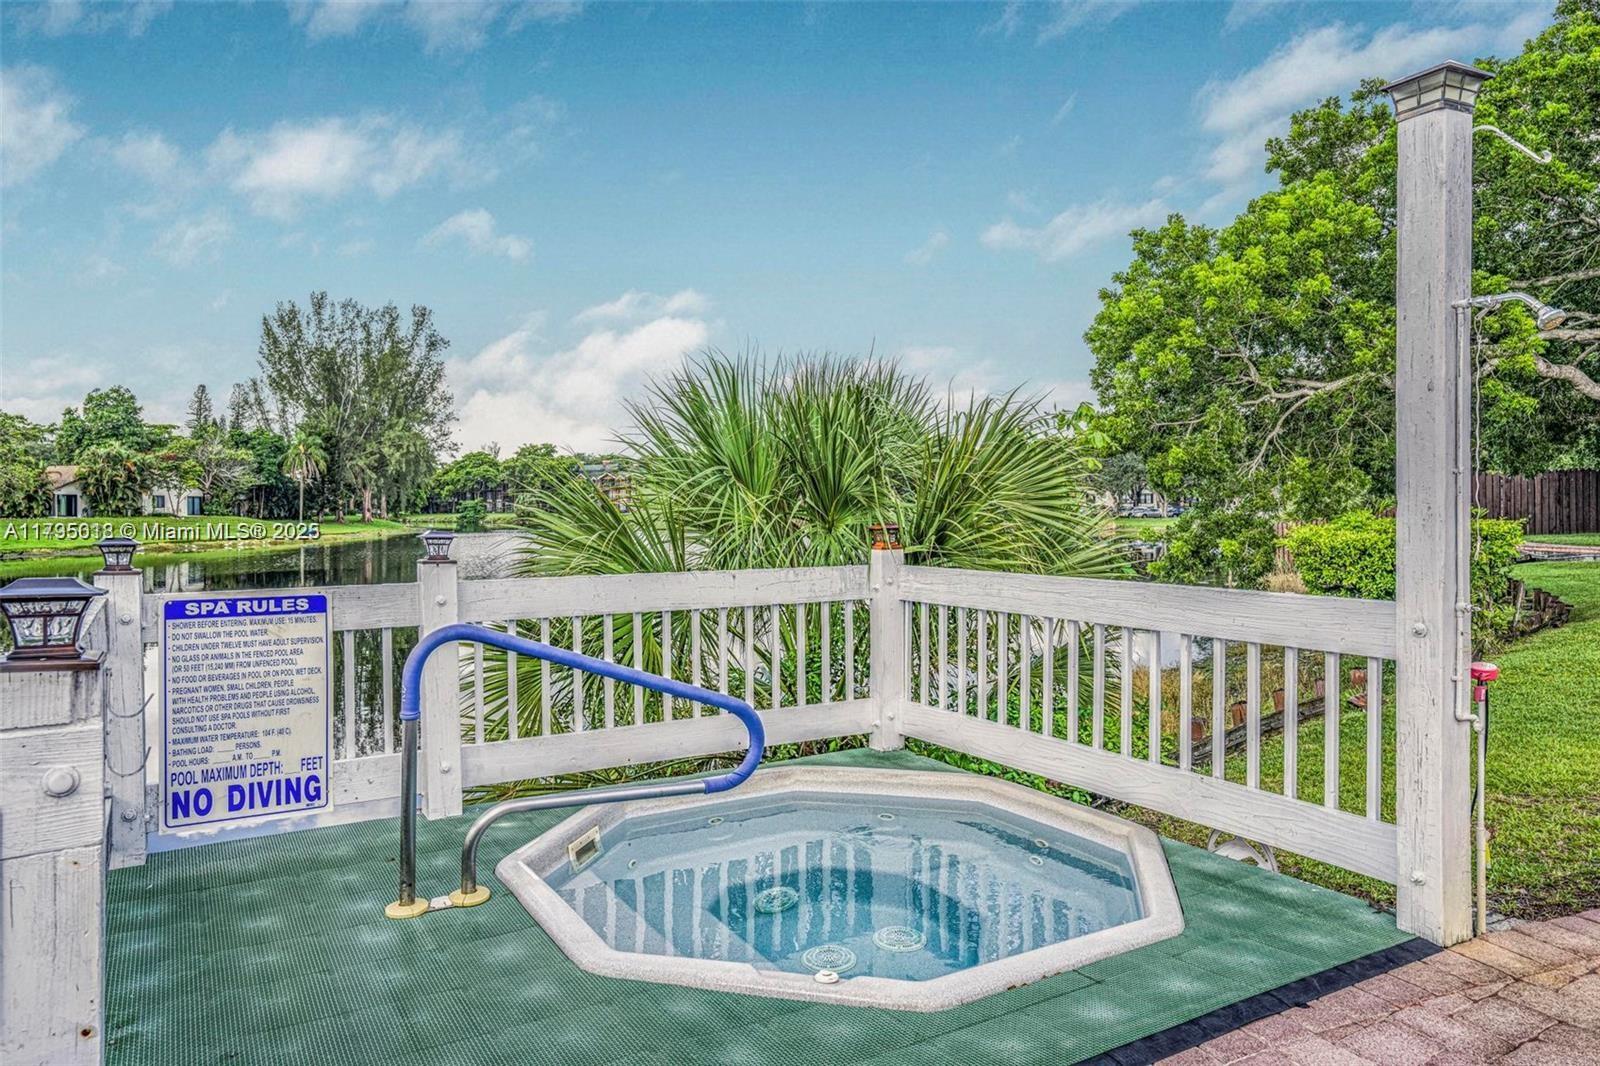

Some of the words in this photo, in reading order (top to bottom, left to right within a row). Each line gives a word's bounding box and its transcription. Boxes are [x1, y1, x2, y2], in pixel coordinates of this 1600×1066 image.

[185, 600, 230, 616] SPA
[236, 598, 309, 613] RULES
[172, 622, 196, 630] SHOWER
[198, 620, 219, 628] BEFORE
[288, 616, 294, 624] 15
[172, 633, 180, 641] DO
[181, 632, 193, 640] NOT
[194, 631, 221, 640] SWALLOW
[223, 630, 233, 638] THE
[172, 644, 199, 652] CHILDREN
[201, 642, 219, 650] UNDER
[221, 641, 241, 649] TWELVE
[243, 640, 257, 648] MUST
[273, 638, 289, 646] ADULT
[172, 655, 180, 663] NO
[181, 654, 200, 662] GLASS
[201, 653, 209, 661] OR
[210, 652, 234, 660] ANIMALS
[184, 664, 189, 672] 50
[191, 664, 204, 672] FEET
[236, 660, 251, 668] FROM
[252, 659, 280, 667] UNFENCED
[172, 676, 180, 684] NO
[182, 675, 197, 683] FOOD
[198, 674, 206, 682] OR
[208, 672, 240, 681] BEVERAGES
[248, 671, 262, 679] POOL
[263, 670, 271, 678] OR
[172, 686, 202, 695] PREGNANT
[226, 683, 244, 691] SMALL
[274, 679, 294, 688] PEOPLE
[172, 697, 186, 705] WITH
[187, 696, 209, 704] HEALTH
[210, 693, 239, 701] PROBLEMS
[252, 690, 272, 699] PEOPLE
[274, 689, 289, 697] USING
[172, 705, 204, 714] NARCOTICS
[205, 704, 213, 712] OR
[214, 703, 233, 711] OTHER
[234, 702, 252, 710] DRUGS
[254, 700, 266, 708] THAT
[267, 699, 285, 707] CAUSE
[286, 696, 320, 705] DROWSINESS
[172, 716, 195, 725] SHOULD
[232, 711, 250, 719] POOLS
[252, 709, 274, 717] WITHOUT
[275, 708, 290, 716] FIRST
[172, 725, 207, 735] CONSULTING
[172, 737, 199, 745] MAXIMUM
[200, 735, 219, 743] WATER
[172, 747, 196, 757] BATHING
[198, 746, 214, 754] LOAD:
[172, 760, 187, 768] POOL
[246, 752, 253, 760] TO
[171, 770, 198, 787] POOL
[200, 764, 247, 784] MAXIMUM
[250, 761, 284, 778] DEPTH:
[300, 756, 323, 772] FEET
[172, 788, 213, 820] NO
[228, 774, 321, 812] DIVING
